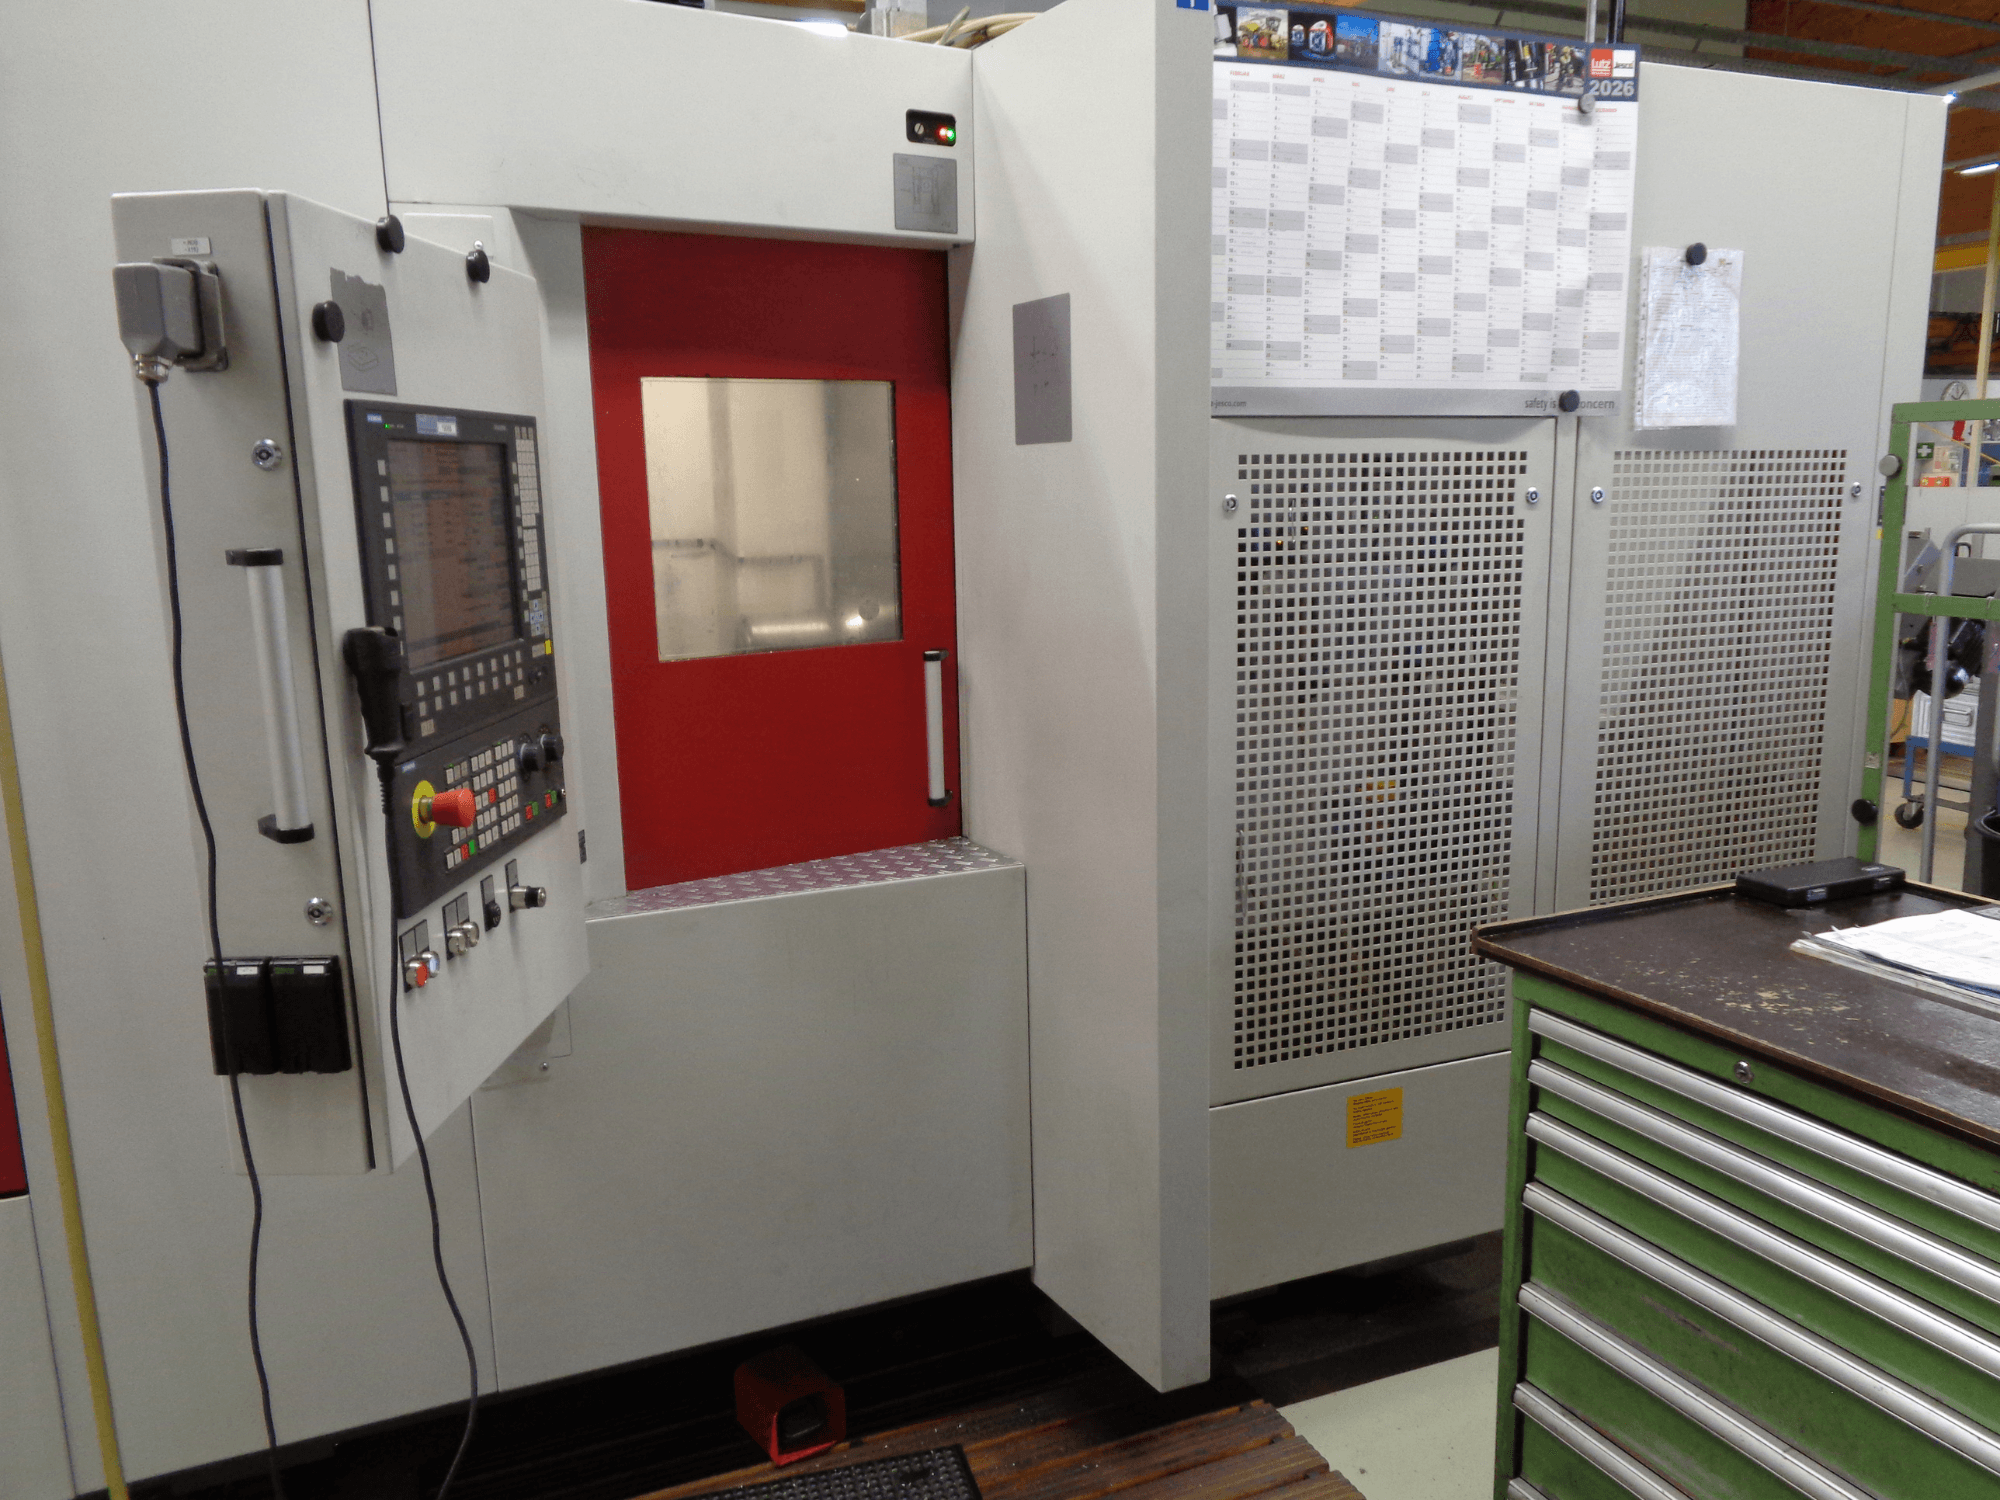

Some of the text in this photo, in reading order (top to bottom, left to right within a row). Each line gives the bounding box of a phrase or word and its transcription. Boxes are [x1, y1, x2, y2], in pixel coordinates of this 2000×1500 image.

[1588, 79, 1635, 97] 2026
[1525, 398, 1615, 411] safety is oncern
